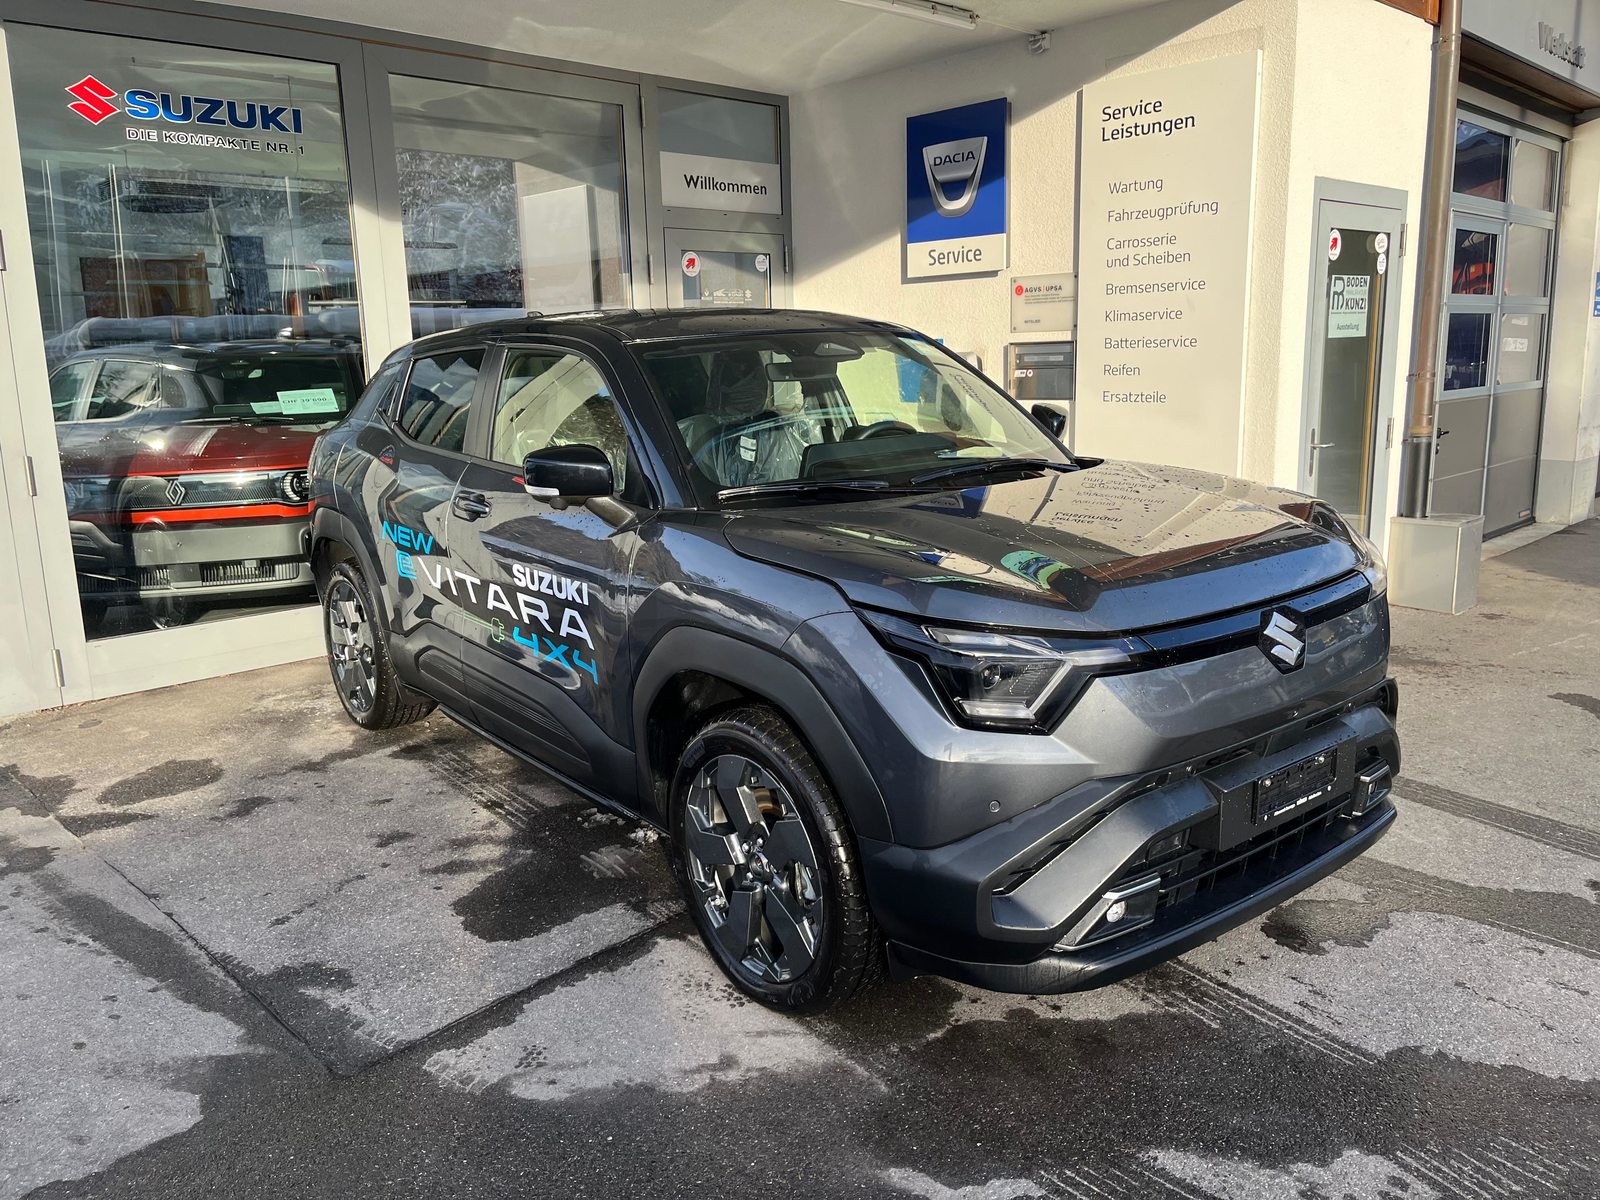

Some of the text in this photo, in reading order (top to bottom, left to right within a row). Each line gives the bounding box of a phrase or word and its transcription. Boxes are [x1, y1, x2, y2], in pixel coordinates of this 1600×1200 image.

[124, 88, 304, 134] SUZUKI
[1102, 99, 1163, 122] Service
[1102, 115, 1196, 142] Leistungen
[126, 128, 158, 142] DIE
[163, 131, 262, 151] KOMPAKTE
[266, 142, 294, 154] NR.
[933, 150, 976, 167] DACIA
[683, 174, 768, 195] Willkommen
[1108, 178, 1164, 194] Wartung
[1107, 200, 1219, 223] Fahrzeugprüfung
[1106, 232, 1177, 250] Carrosserie
[928, 246, 982, 266] Service
[1106, 250, 1191, 268] und Scheiben
[1105, 278, 1206, 296] Bremsenservice
[1346, 276, 1368, 287] BODEN
[1105, 307, 1183, 323] Klimaservice
[1104, 335, 1198, 350] Batterieservice
[1103, 363, 1141, 376] Reifen
[1102, 390, 1167, 404] Ersatzteile
[381, 520, 434, 554] NEW
[512, 563, 590, 606] SUZUKI
[417, 556, 595, 651] VITARA
